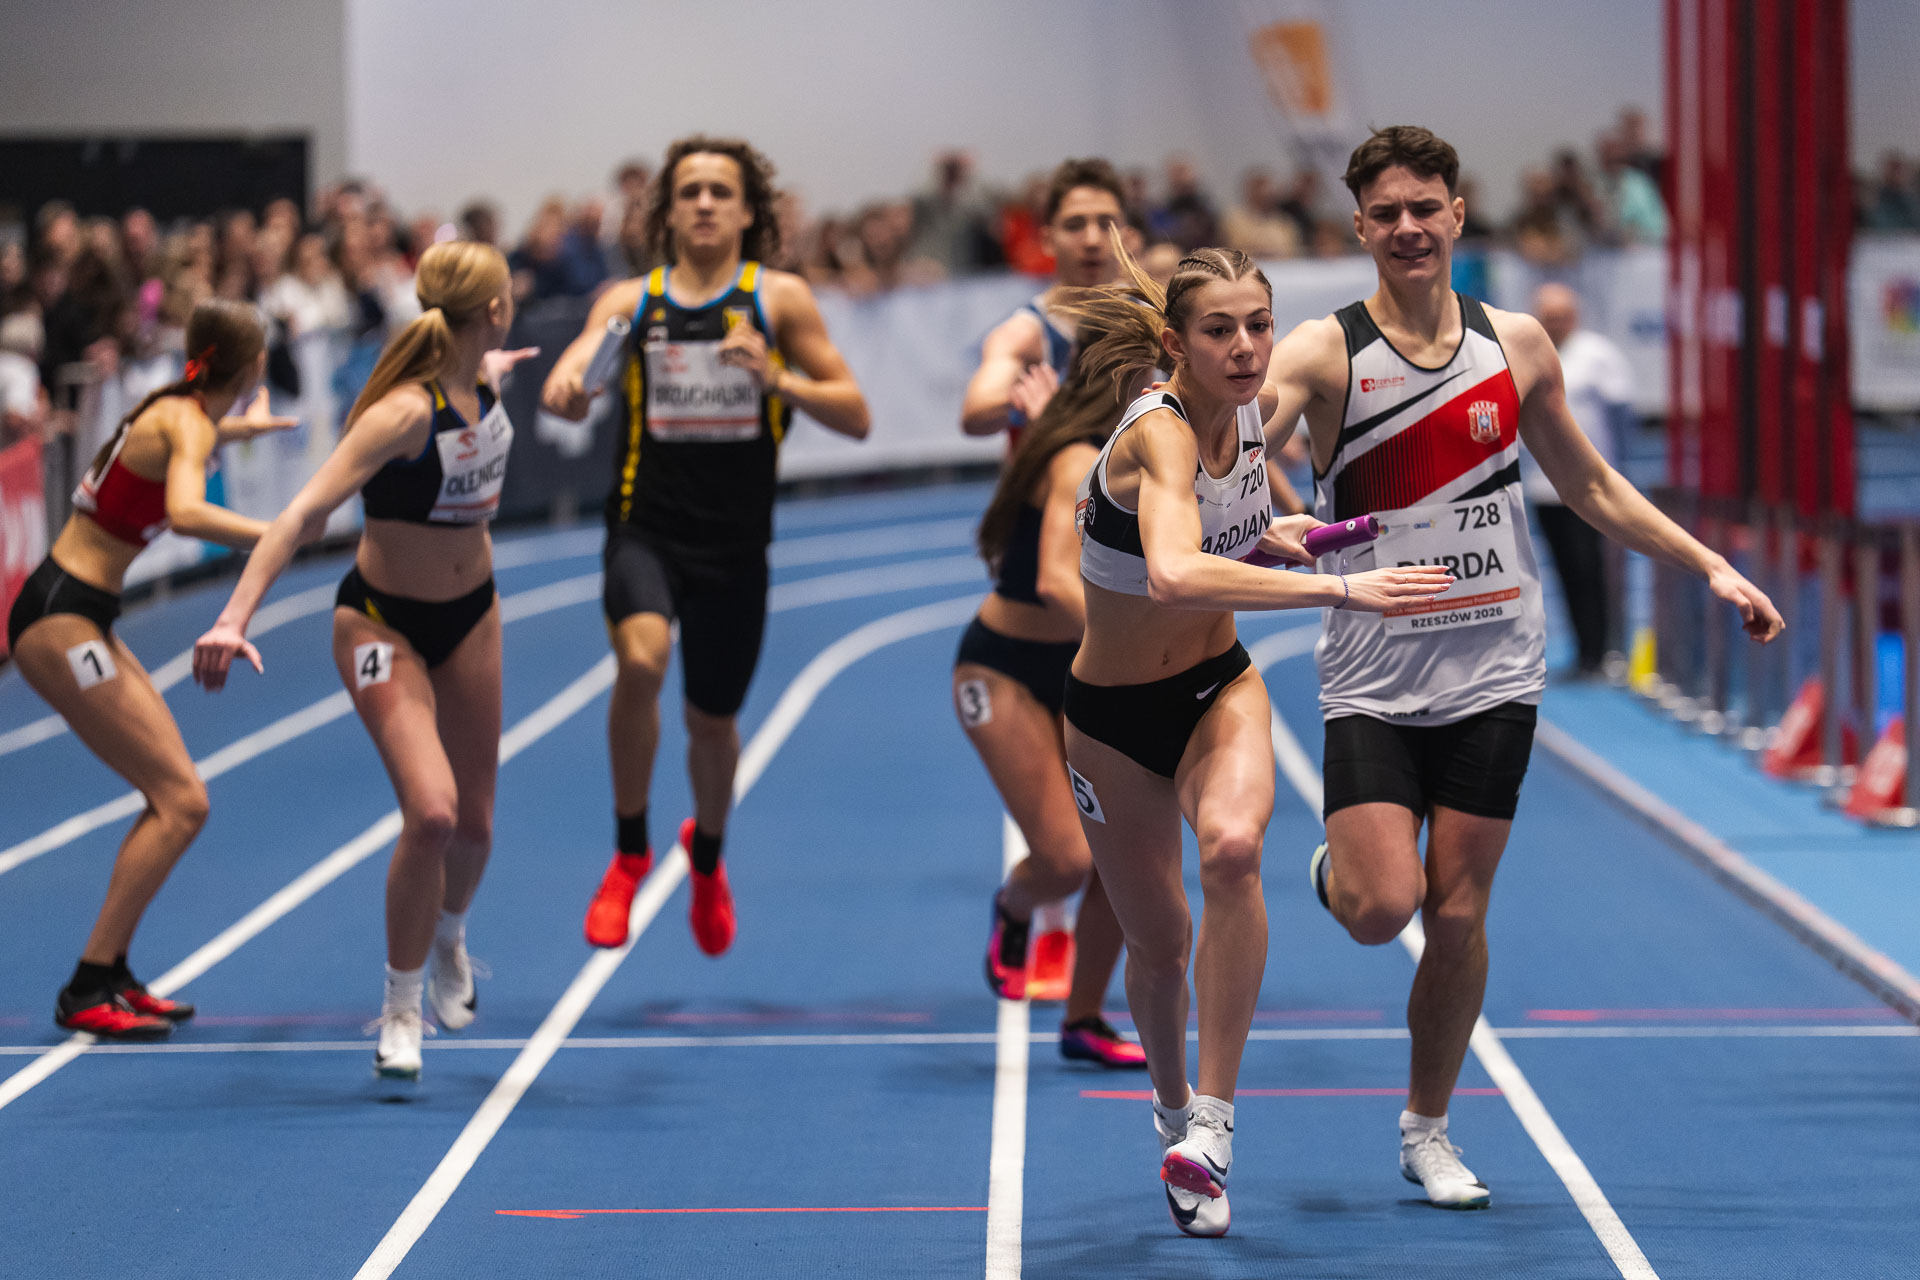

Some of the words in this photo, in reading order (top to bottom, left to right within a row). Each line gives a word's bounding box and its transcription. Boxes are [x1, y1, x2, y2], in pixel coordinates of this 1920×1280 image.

[1240, 463, 1264, 499] 720
[1454, 502, 1501, 532] 728
[1397, 548, 1504, 580] RDA
[1411, 611, 1471, 629] RZESZÓW
[1474, 606, 1503, 620] 2026
[83, 649, 103, 676] 1
[361, 649, 381, 679] 4
[967, 687, 983, 720] 3
[1073, 773, 1095, 813] 5
